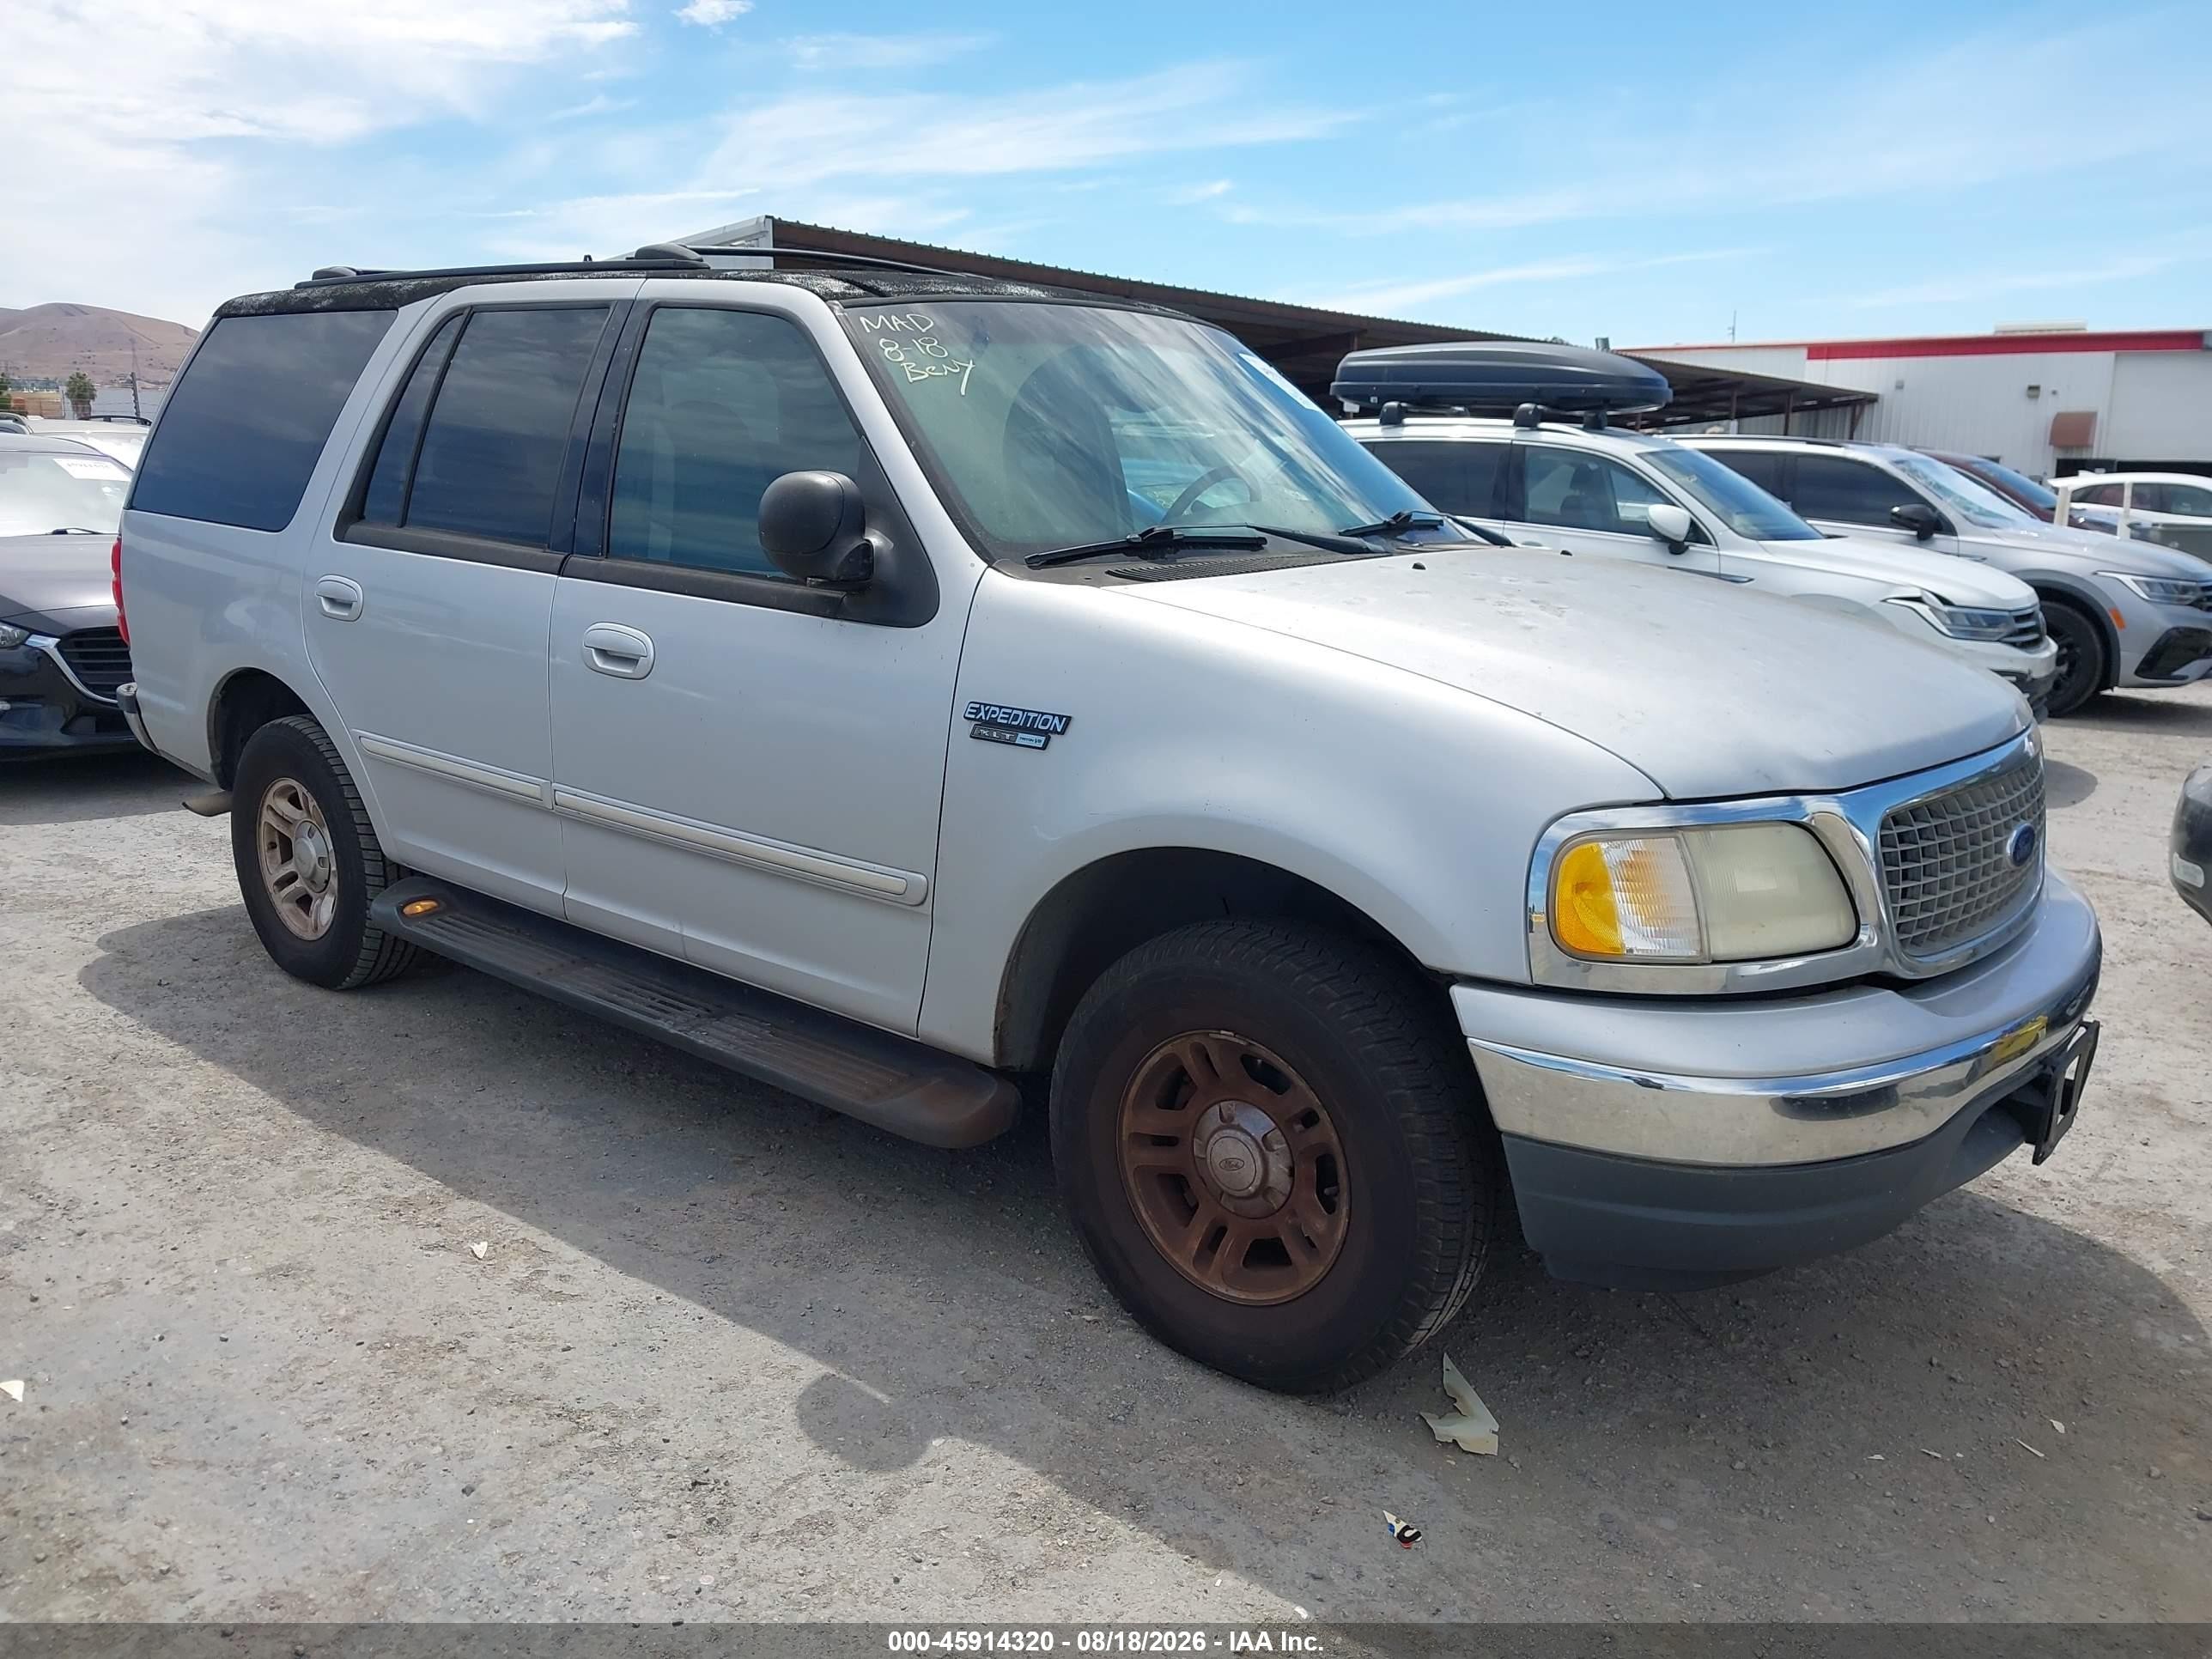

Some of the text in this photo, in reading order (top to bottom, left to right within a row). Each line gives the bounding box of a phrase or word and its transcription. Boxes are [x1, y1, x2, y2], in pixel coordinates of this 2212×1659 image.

[860, 313, 933, 332] MAD
[878, 337, 949, 362] 8-18
[964, 702, 1066, 732] EXPEDITION
